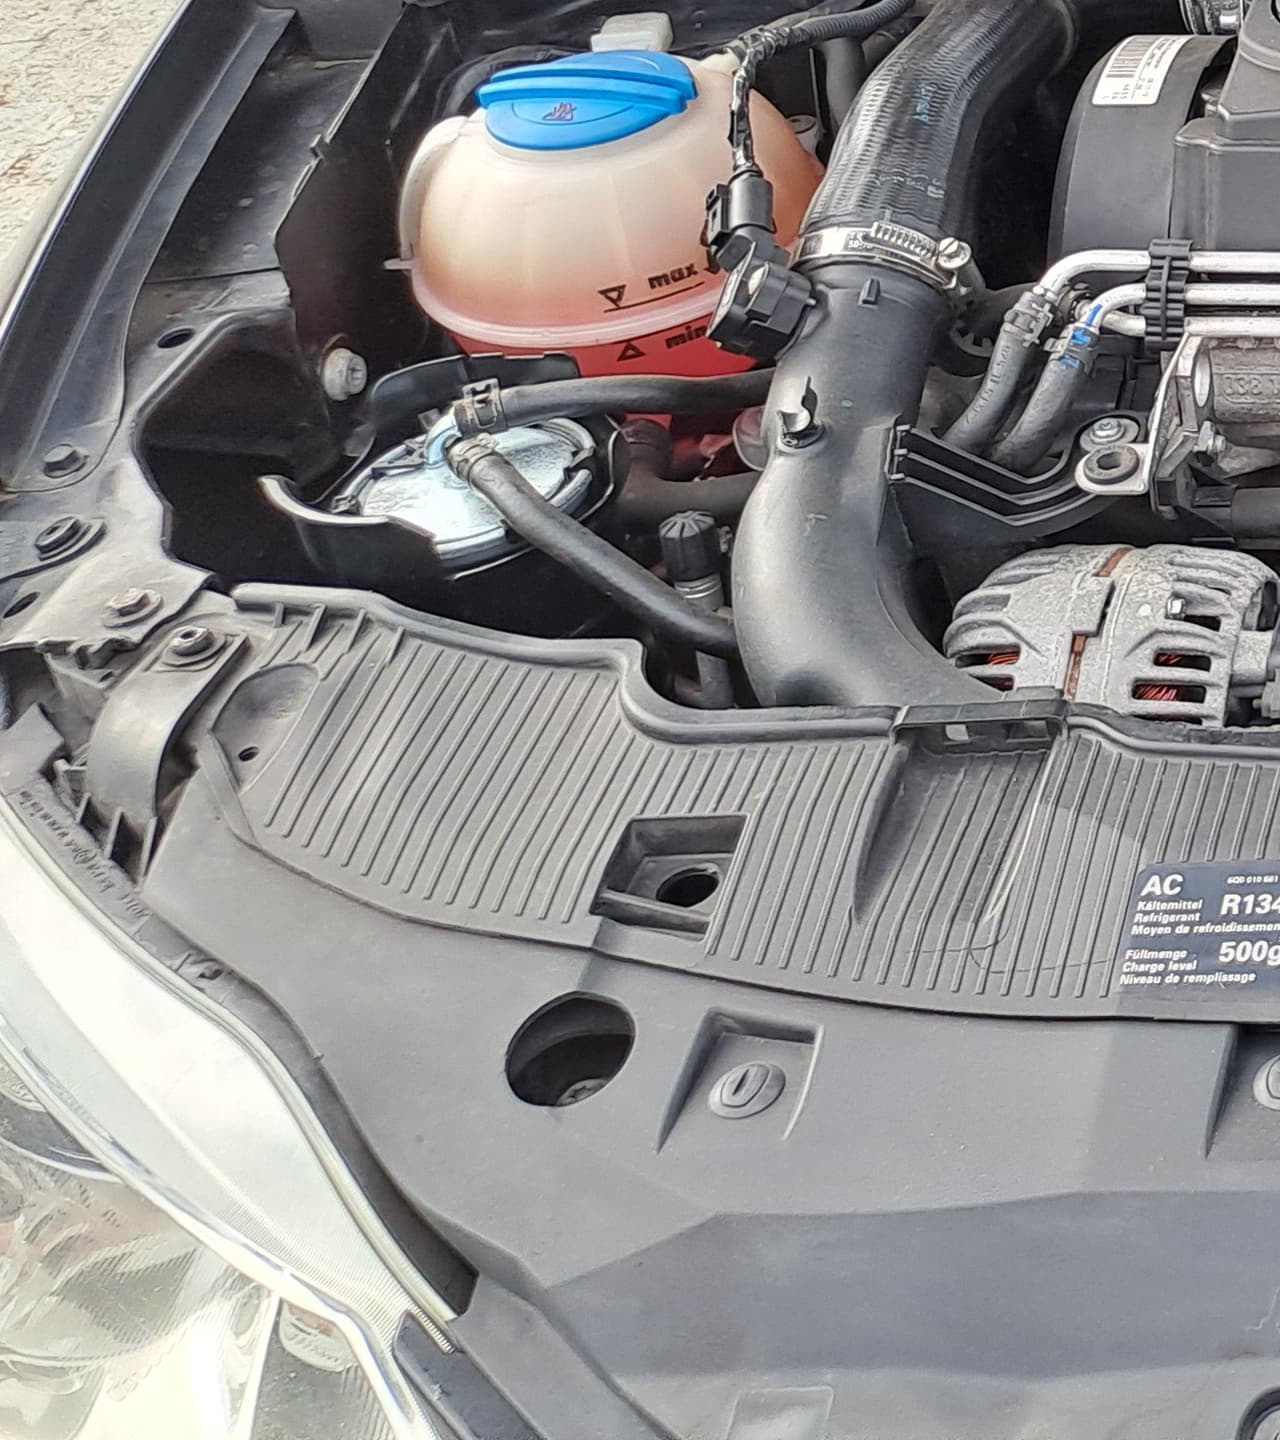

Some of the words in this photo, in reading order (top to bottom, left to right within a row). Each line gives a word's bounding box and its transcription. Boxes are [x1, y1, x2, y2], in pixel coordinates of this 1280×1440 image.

[647, 263, 699, 289] max
[665, 325, 708, 349] min
[1140, 874, 1184, 897] AC
[1134, 912, 1201, 924] Refrigerant
[1131, 925, 1171, 936] Moyen
[1175, 924, 1189, 934] de
[1125, 949, 1188, 961] Füllmenge
[1122, 962, 1165, 973] Charge
[1168, 960, 1197, 971] level
[1119, 973, 1161, 985] Niveau
[1165, 972, 1179, 983] de
[1183, 971, 1257, 984] remplissage
